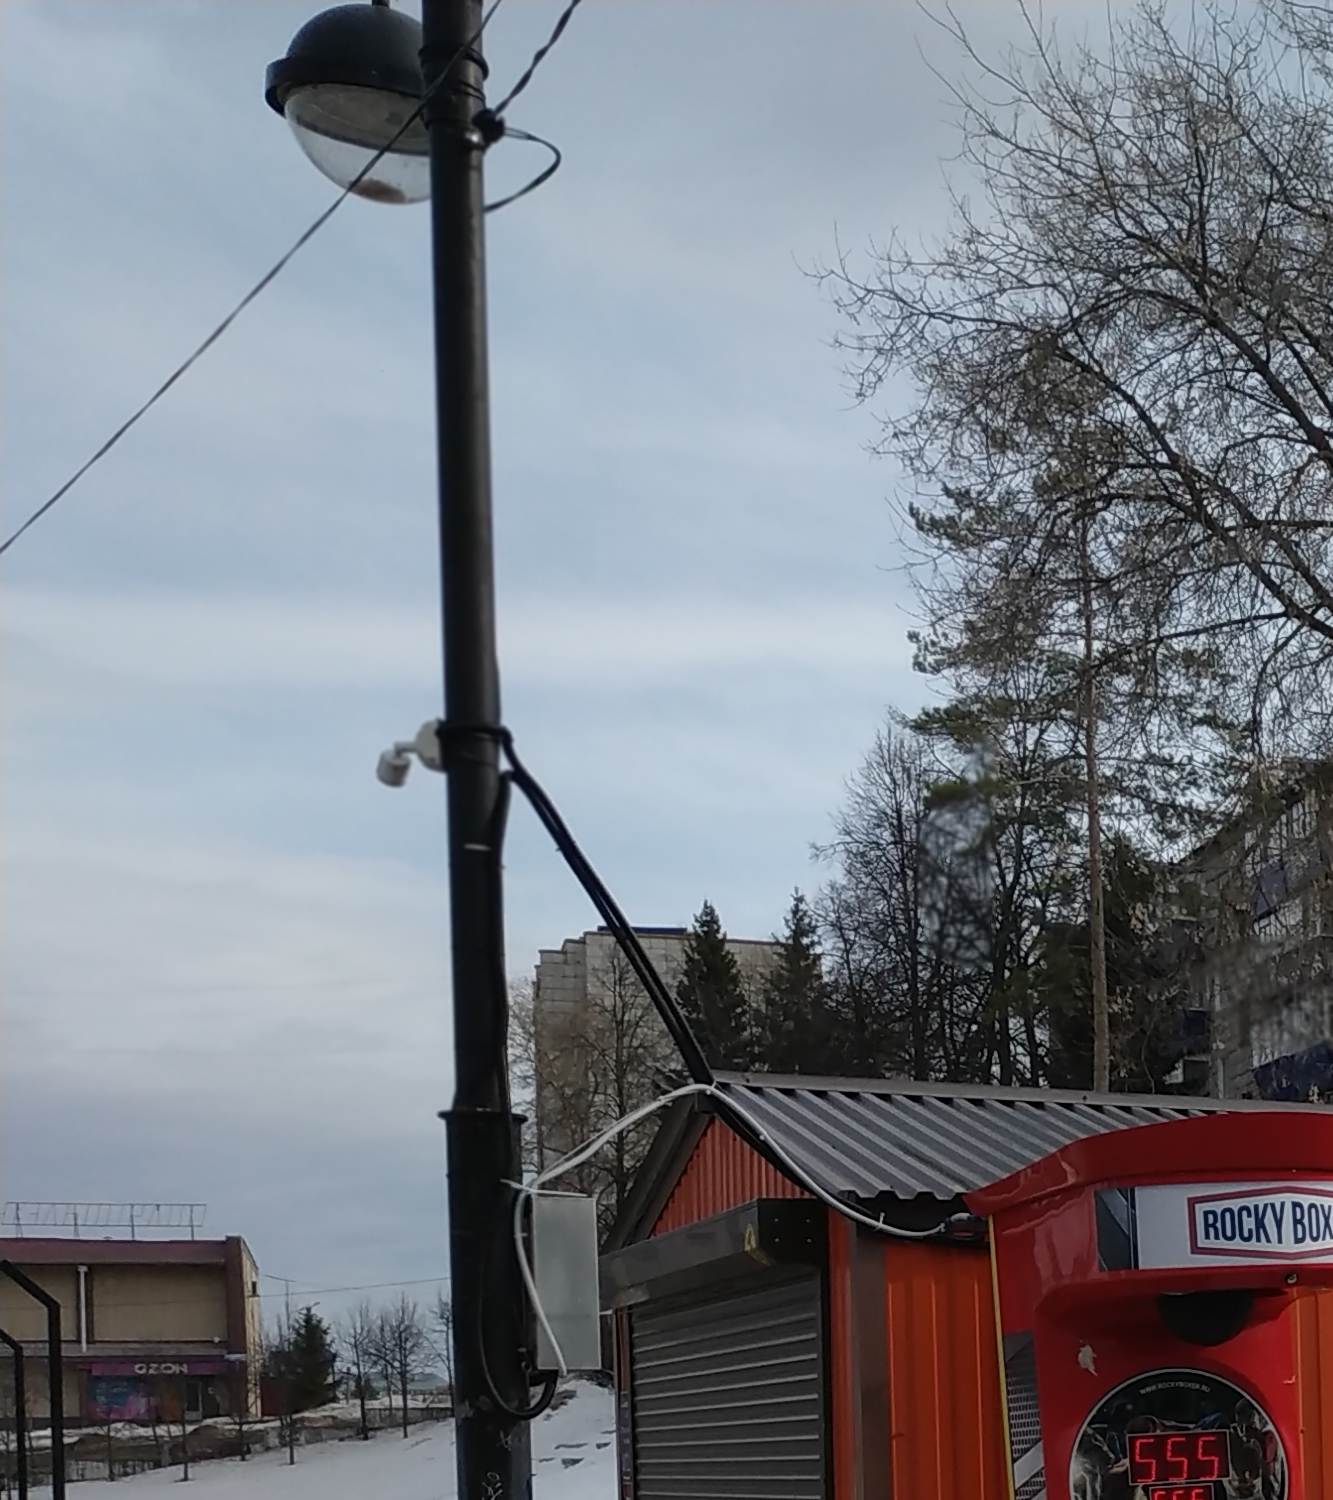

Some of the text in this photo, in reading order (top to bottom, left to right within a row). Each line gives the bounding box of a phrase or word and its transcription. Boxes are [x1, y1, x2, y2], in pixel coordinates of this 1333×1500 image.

[1203, 1201, 1285, 1244] ROCKY
[134, 1363, 188, 1374] OZON
[1135, 1437, 1219, 1482] 555
